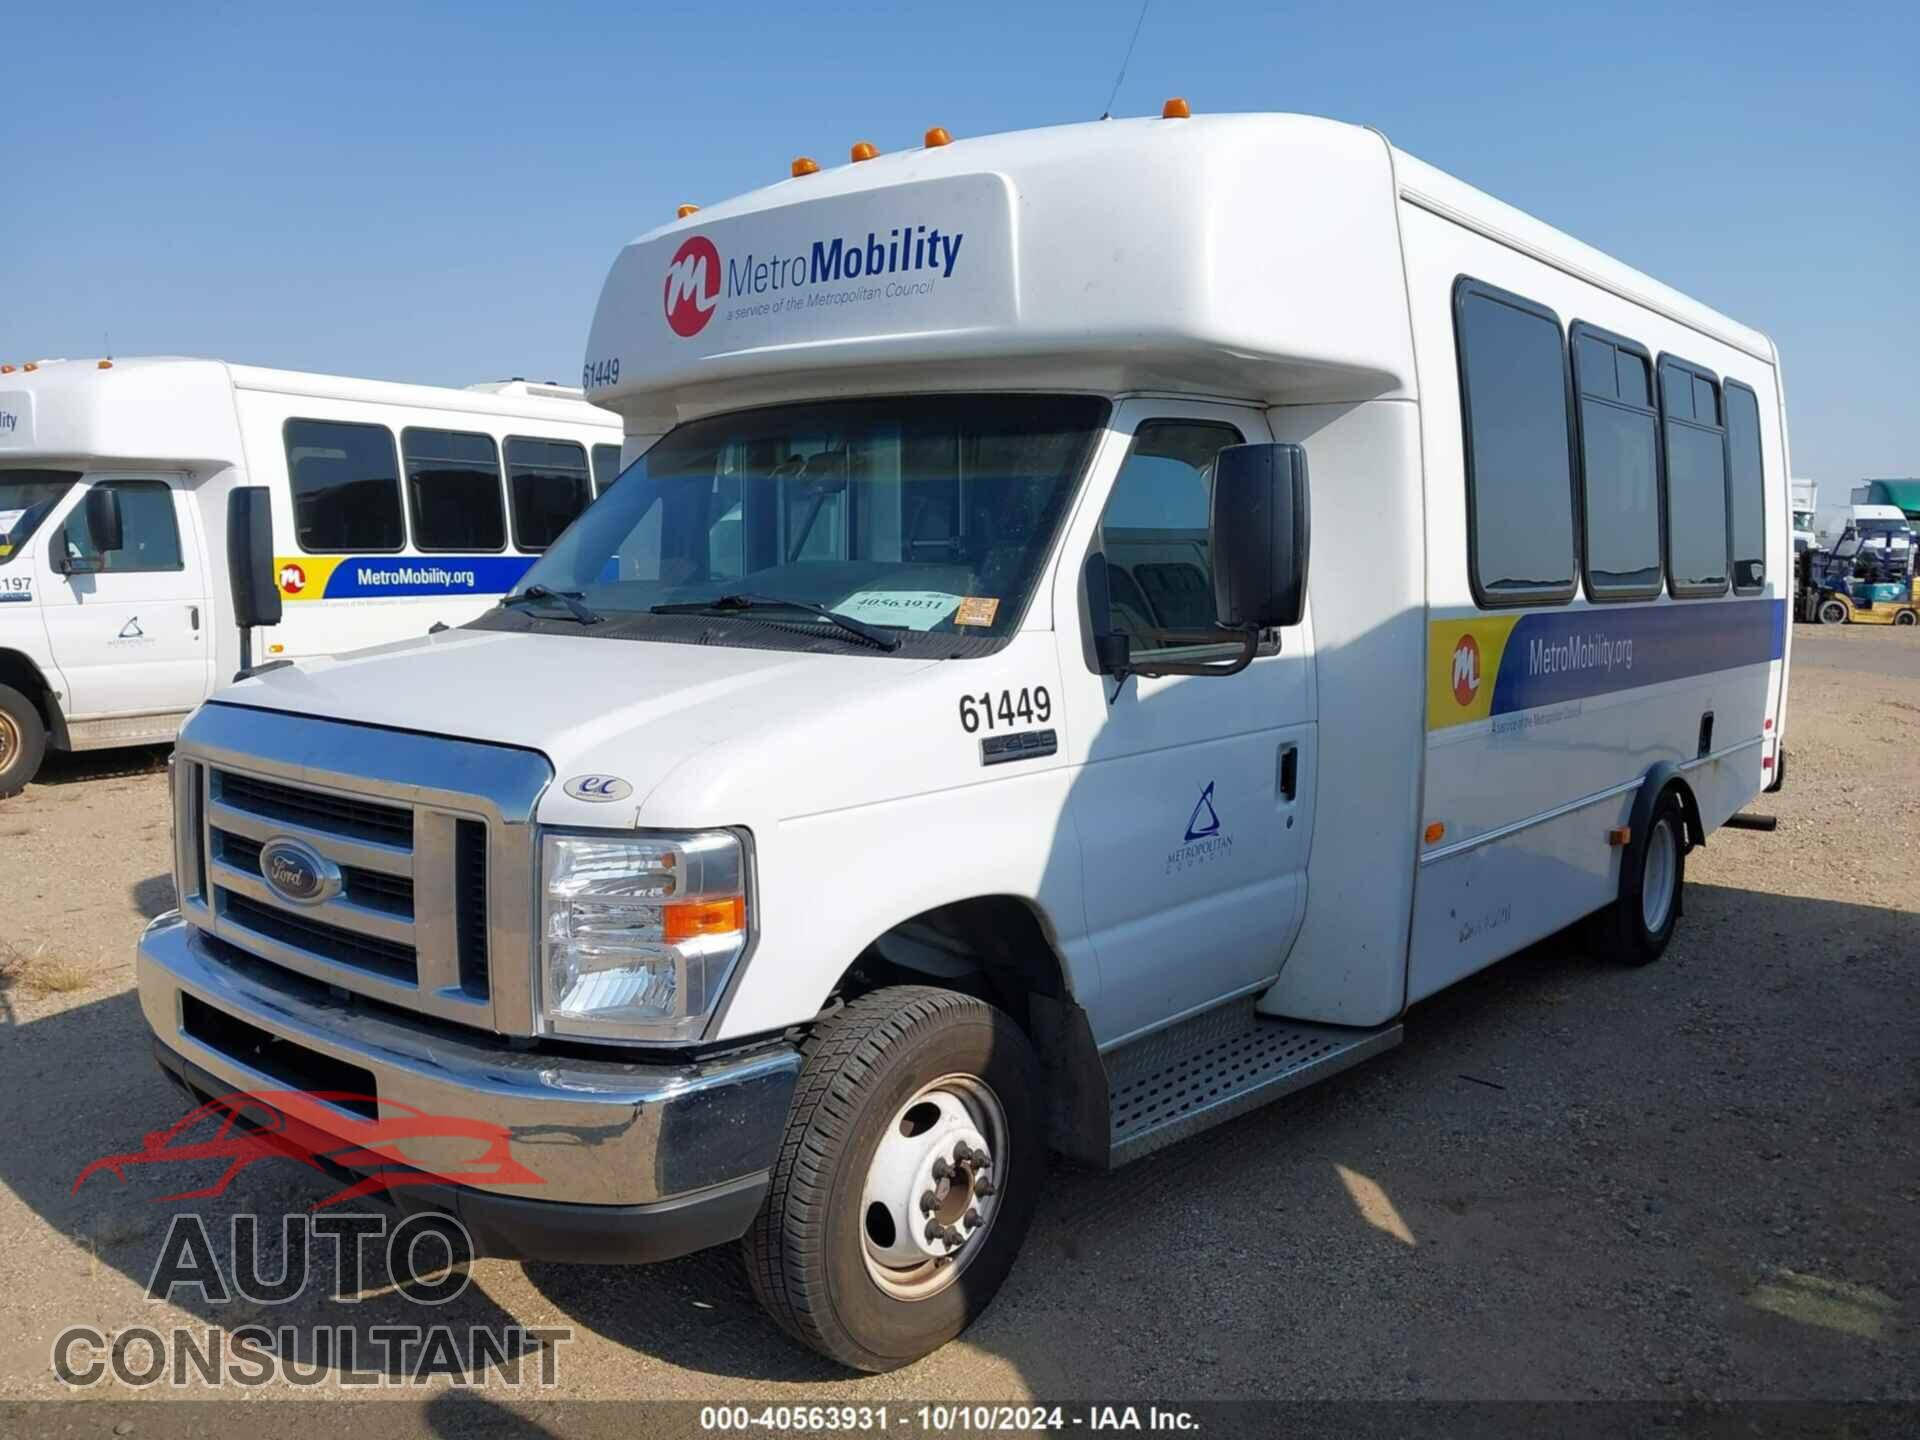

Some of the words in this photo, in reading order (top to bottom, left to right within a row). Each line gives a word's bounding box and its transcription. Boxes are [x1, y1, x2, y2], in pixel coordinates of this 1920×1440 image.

[727, 226, 963, 298] MetroMobility
[726, 310, 734, 320] a
[735, 303, 769, 319] service
[772, 300, 785, 313] of
[786, 296, 804, 312] the
[806, 286, 882, 308] Metropolitan
[885, 279, 935, 298] Council
[582, 358, 620, 390] 61449
[357, 567, 475, 587] MetroMobility.org
[1529, 632, 1633, 676] MetroMobility.org
[959, 686, 1051, 734] 61449
[1166, 834, 1233, 863] METROPOLITAN
[271, 855, 304, 888] Ford
